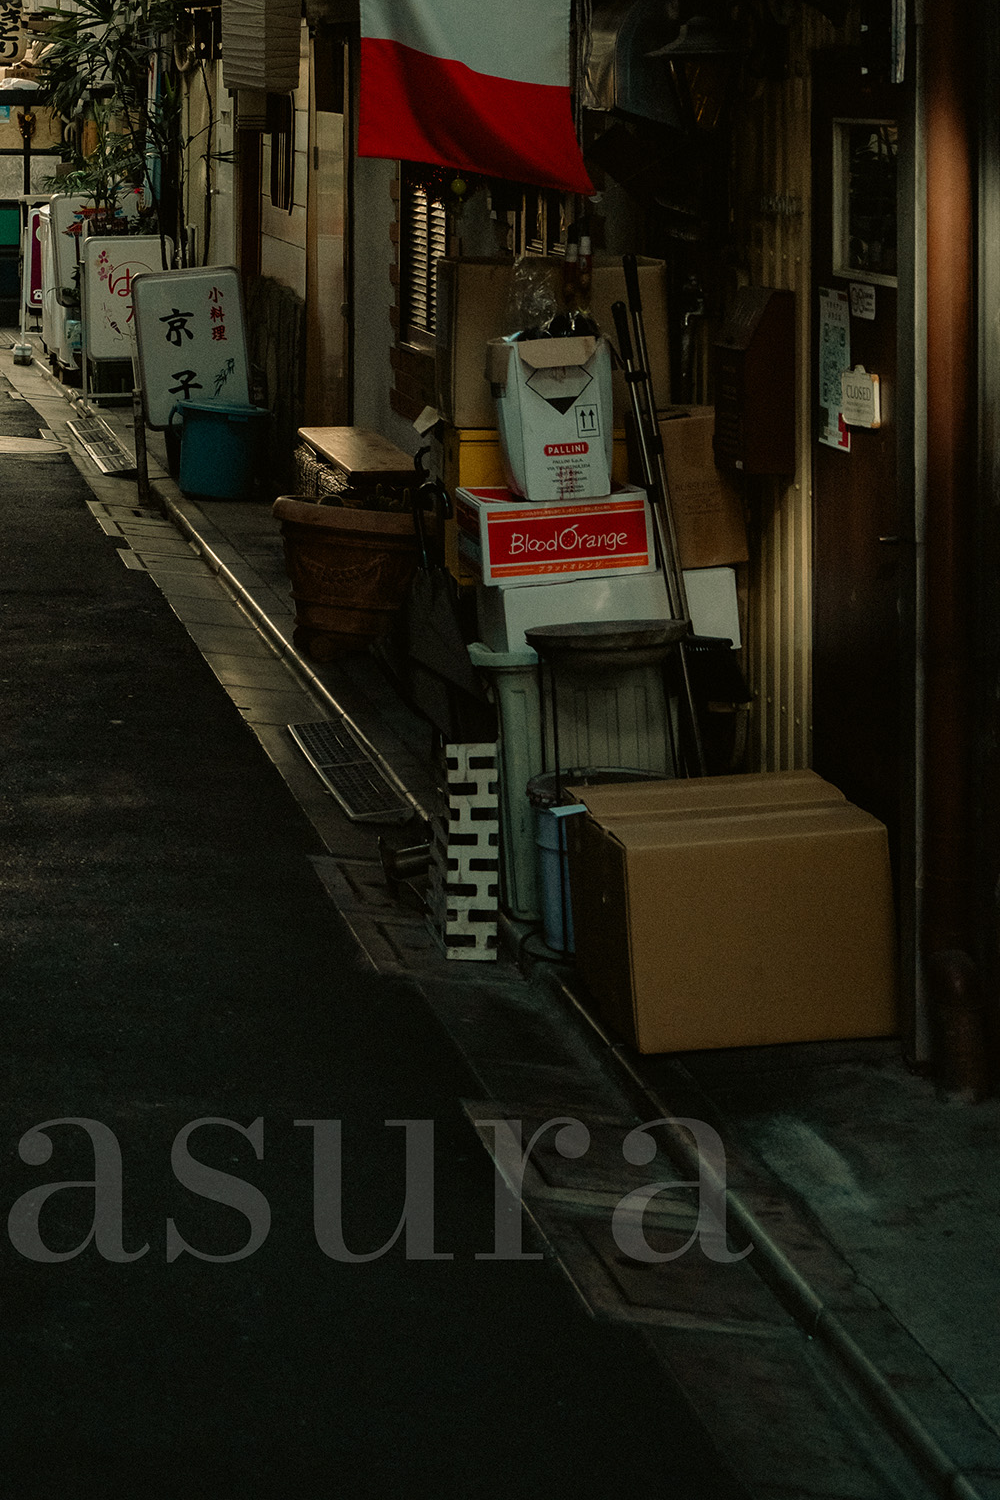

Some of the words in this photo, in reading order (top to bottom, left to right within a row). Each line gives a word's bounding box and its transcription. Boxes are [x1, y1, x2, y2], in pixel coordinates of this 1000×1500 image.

[208, 287, 228, 341] 小料理
[159, 308, 203, 399] 京子
[846, 385, 871, 401] CLOSED
[548, 444, 585, 454] PALLINI
